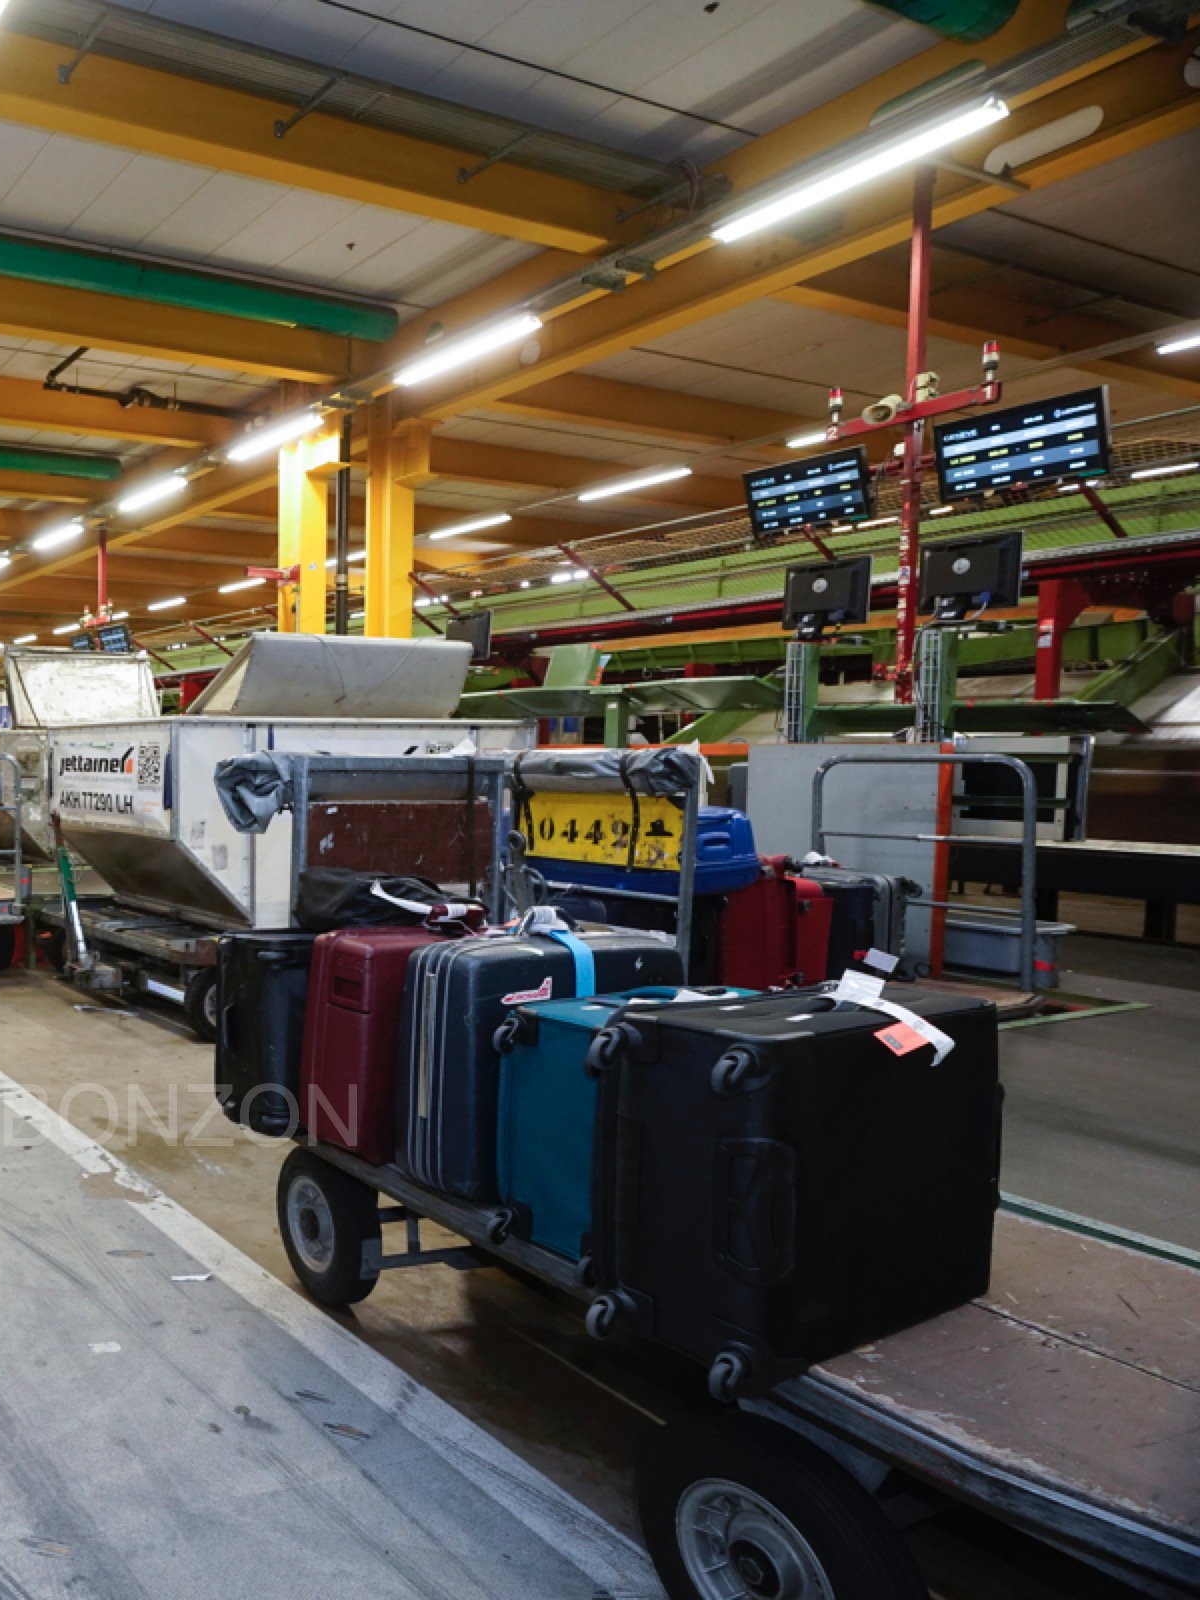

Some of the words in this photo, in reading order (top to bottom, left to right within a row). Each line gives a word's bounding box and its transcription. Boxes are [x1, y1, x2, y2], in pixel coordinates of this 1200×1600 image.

[983, 385, 993, 399] 1
[827, 427, 838, 440] 2
[59, 746, 134, 776] jettainer
[116, 794, 134, 814] LH
